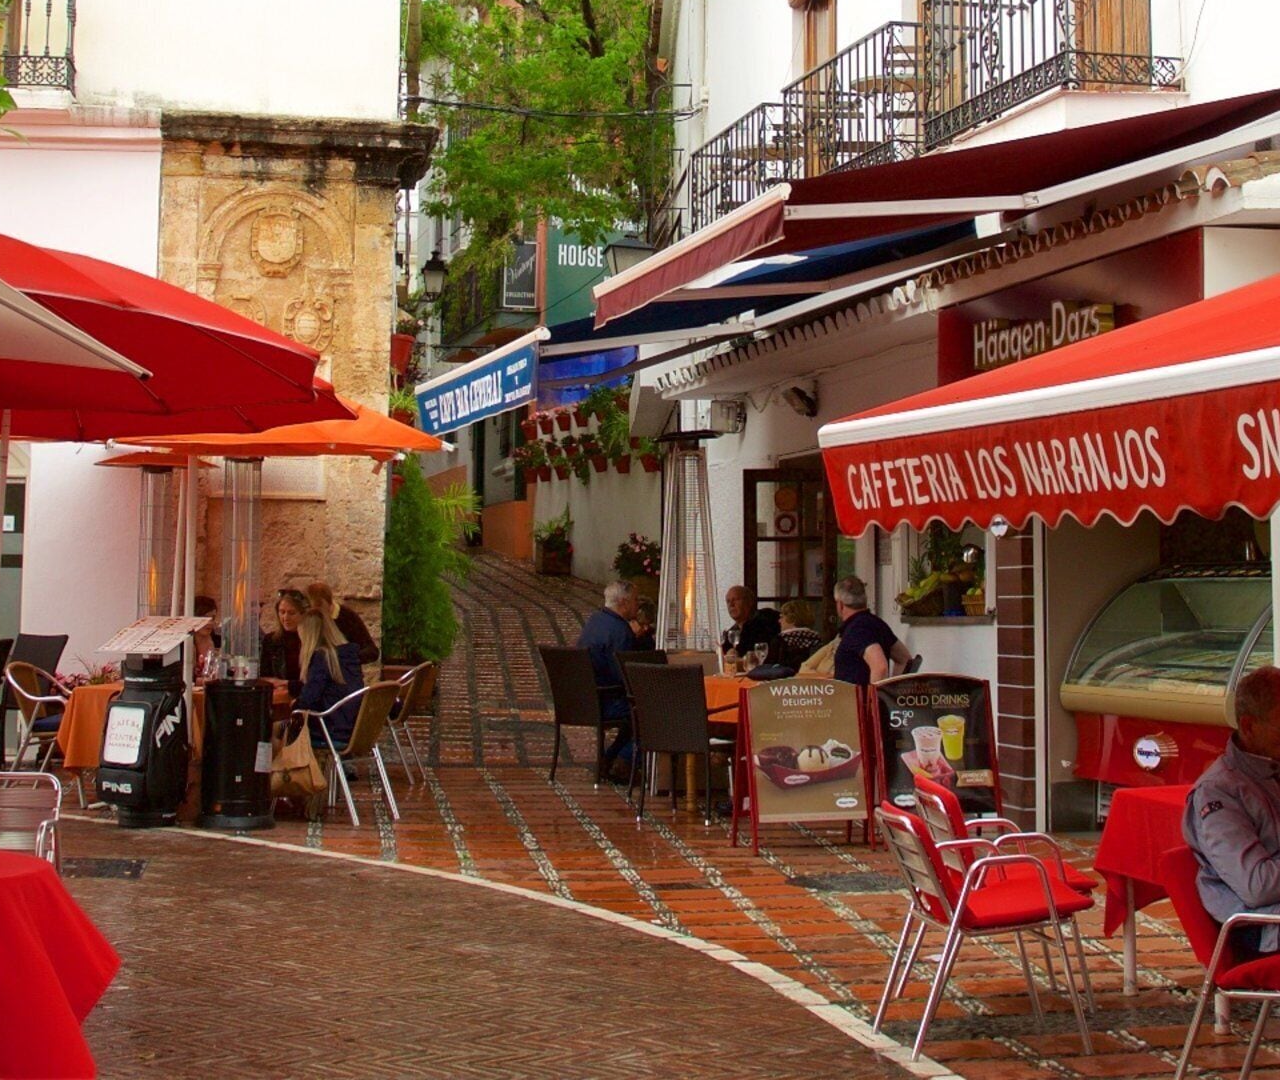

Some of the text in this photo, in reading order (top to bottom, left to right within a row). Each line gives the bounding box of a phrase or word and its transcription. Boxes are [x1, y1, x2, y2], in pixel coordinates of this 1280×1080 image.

[557, 243, 604, 267] HOUSE
[847, 426, 1166, 510] CAFETERIA LOS NARANJOS
[770, 684, 834, 696] WARMING
[782, 698, 823, 706] DELIGHTS
[897, 694, 970, 706] COLD DRINKS
[102, 780, 132, 794] PING
